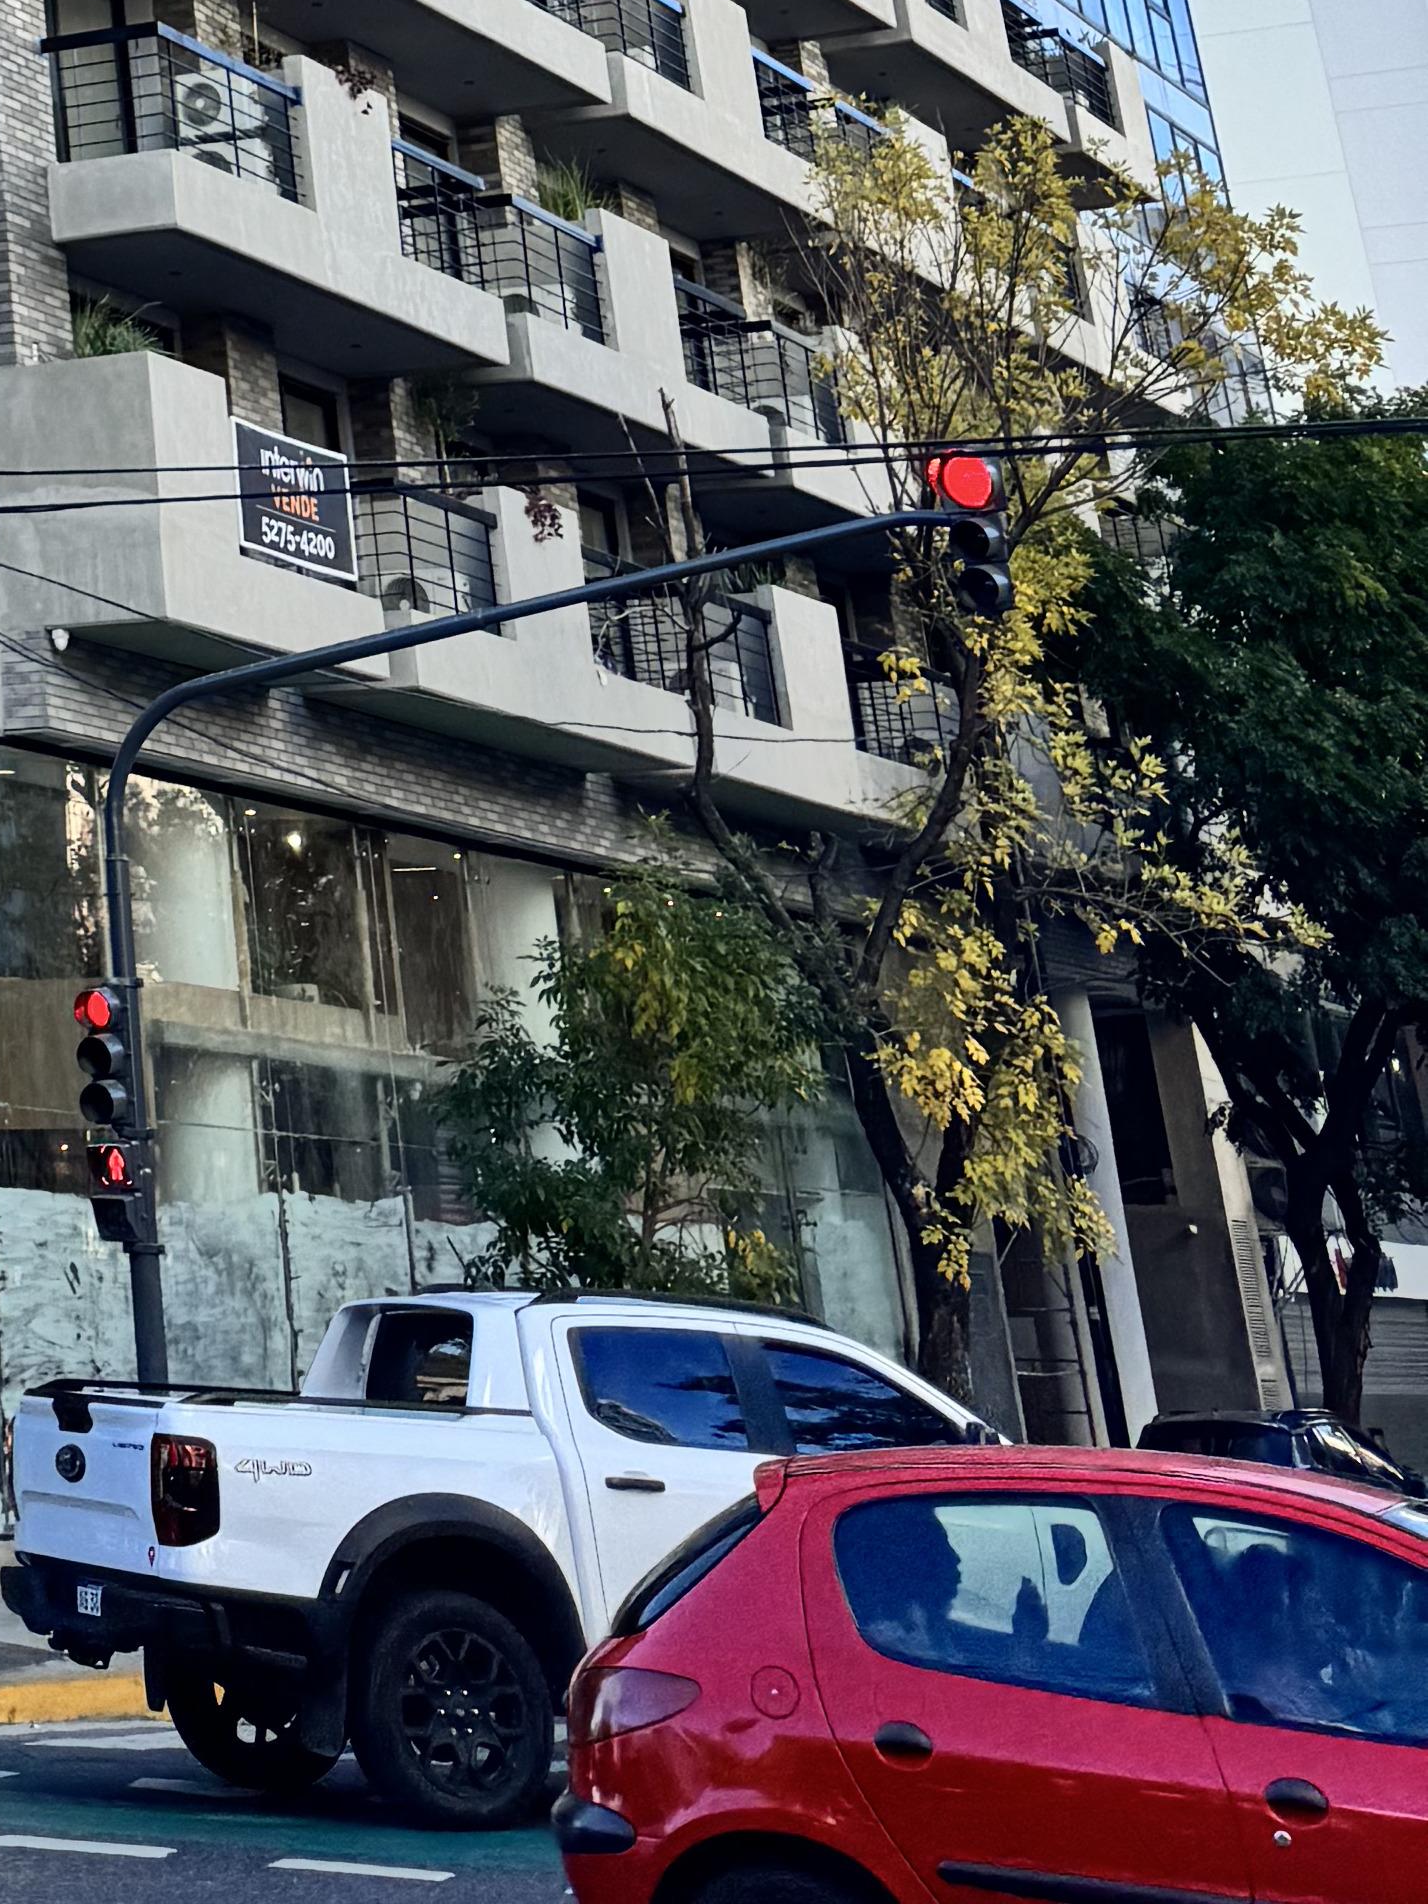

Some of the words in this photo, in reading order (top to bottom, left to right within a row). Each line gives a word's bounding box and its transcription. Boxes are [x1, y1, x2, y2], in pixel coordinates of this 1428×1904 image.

[271, 482, 320, 522] VENDE
[261, 516, 336, 560] 5275-4200
[234, 1458, 313, 1483] 4WD
